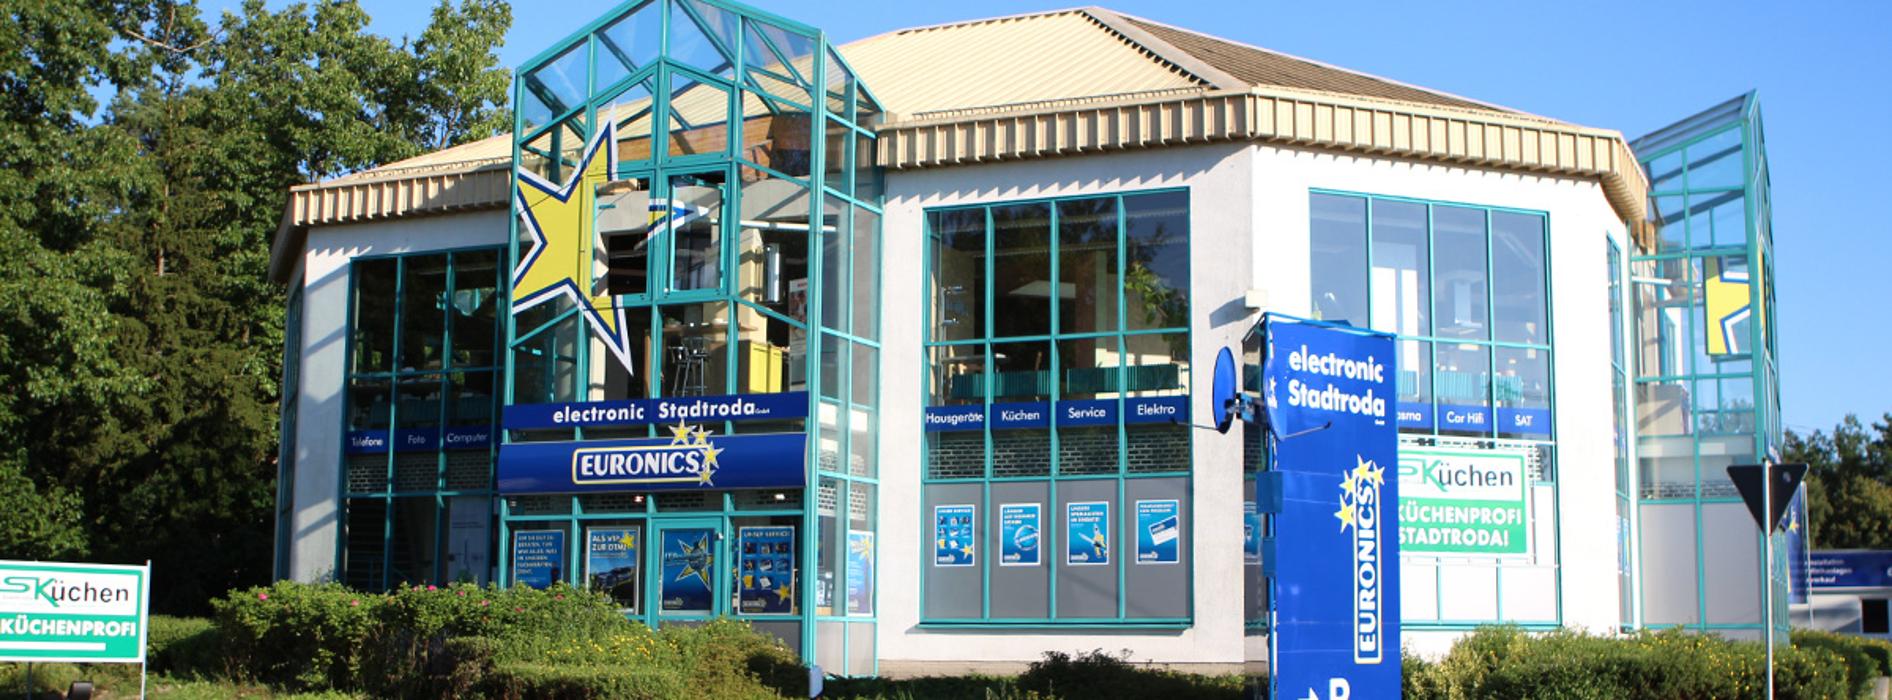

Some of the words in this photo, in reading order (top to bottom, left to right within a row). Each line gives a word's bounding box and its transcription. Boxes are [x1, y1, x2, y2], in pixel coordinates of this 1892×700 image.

[1288, 344, 1384, 384] electronic
[1288, 380, 1385, 418] Stadtroda
[552, 402, 645, 424] electronic
[658, 398, 755, 419] Stadtroda
[1001, 408, 1041, 422] Küchen
[1068, 405, 1107, 420] Service
[1137, 403, 1176, 417] Elektro
[1446, 411, 1465, 424] Car
[925, 411, 985, 427] Hausgeräte
[1514, 415, 1534, 427] SAT
[351, 435, 384, 448] Telefone
[407, 434, 426, 446] Foto
[446, 432, 489, 444] Computer
[580, 450, 700, 477] EURONICS
[1356, 485, 1376, 652] EURONICS
[0, 615, 137, 637] KÜCHENPROFI
